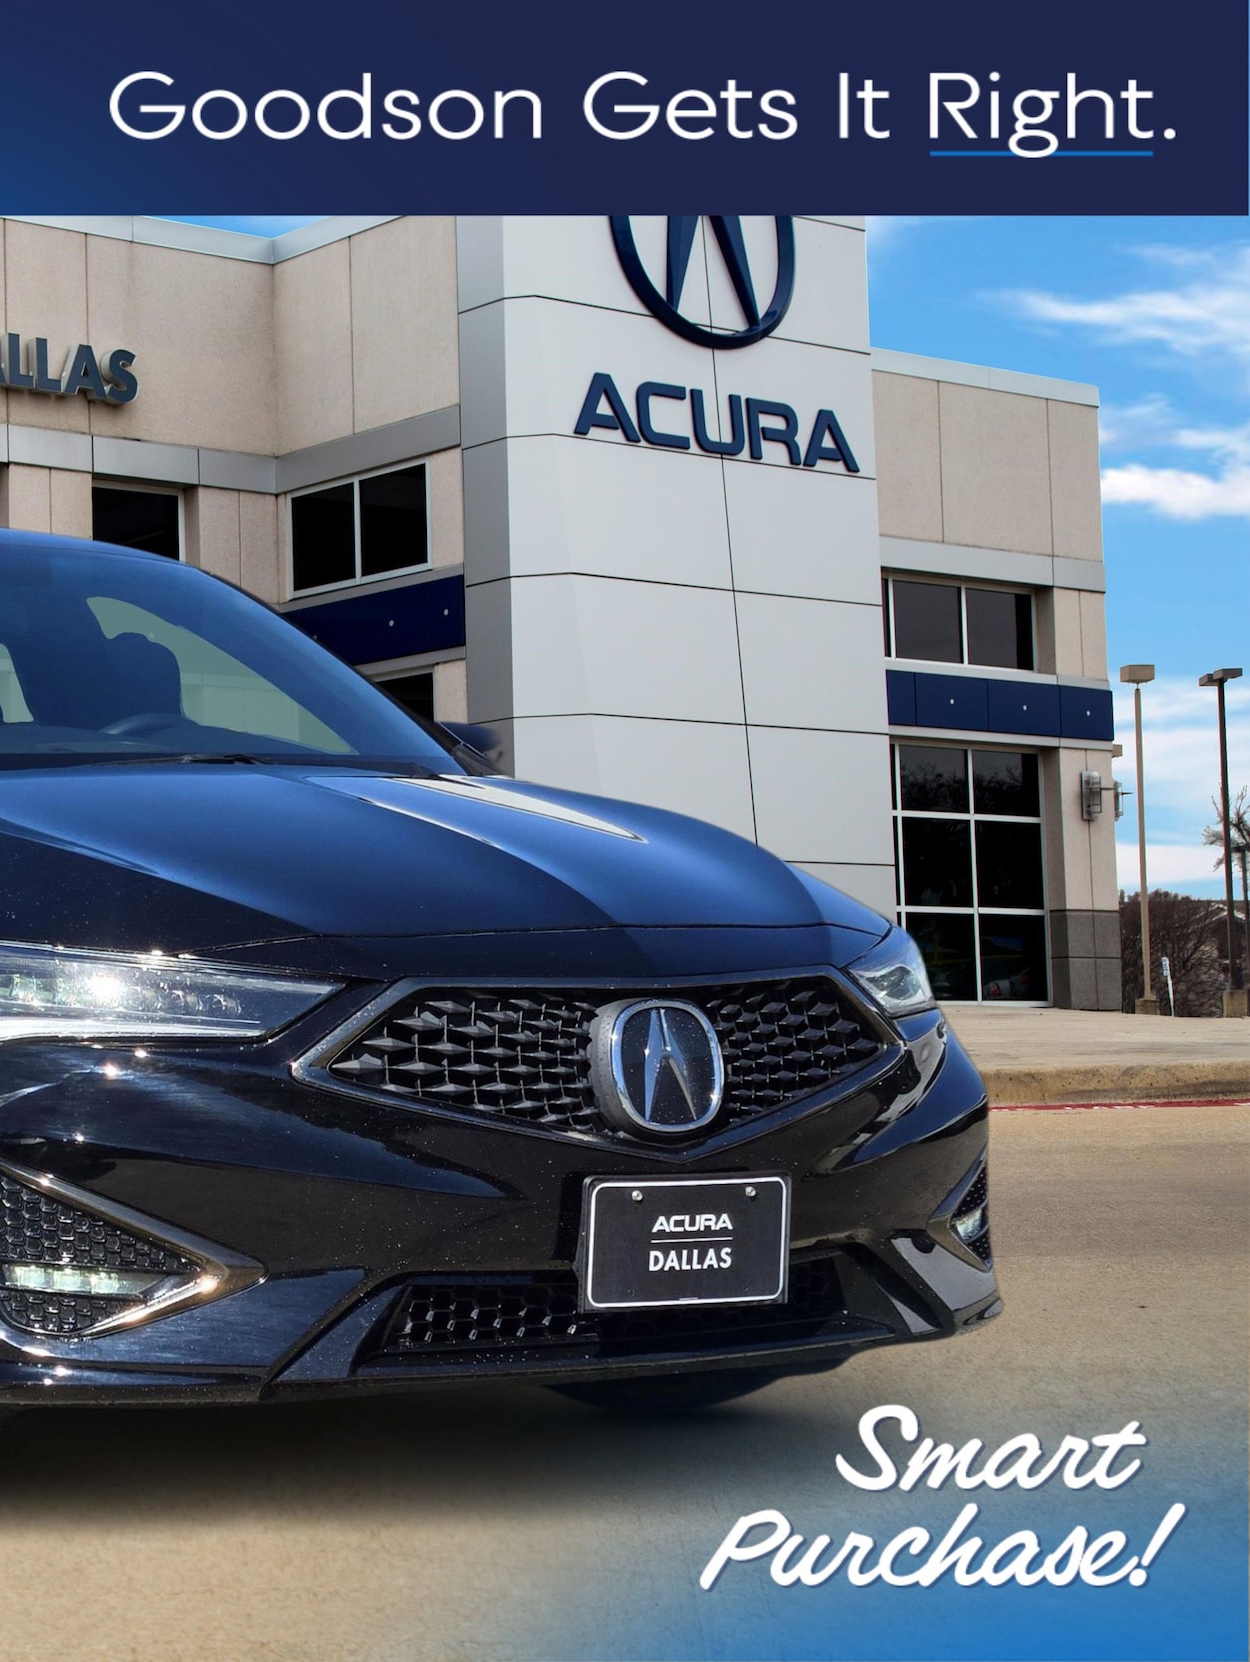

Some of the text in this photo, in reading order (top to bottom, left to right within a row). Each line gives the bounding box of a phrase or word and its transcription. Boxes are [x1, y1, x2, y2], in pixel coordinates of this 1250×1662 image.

[573, 371, 861, 473] ACURA
[651, 1213, 733, 1233] ACURA
[648, 1247, 733, 1272] DALLAS
